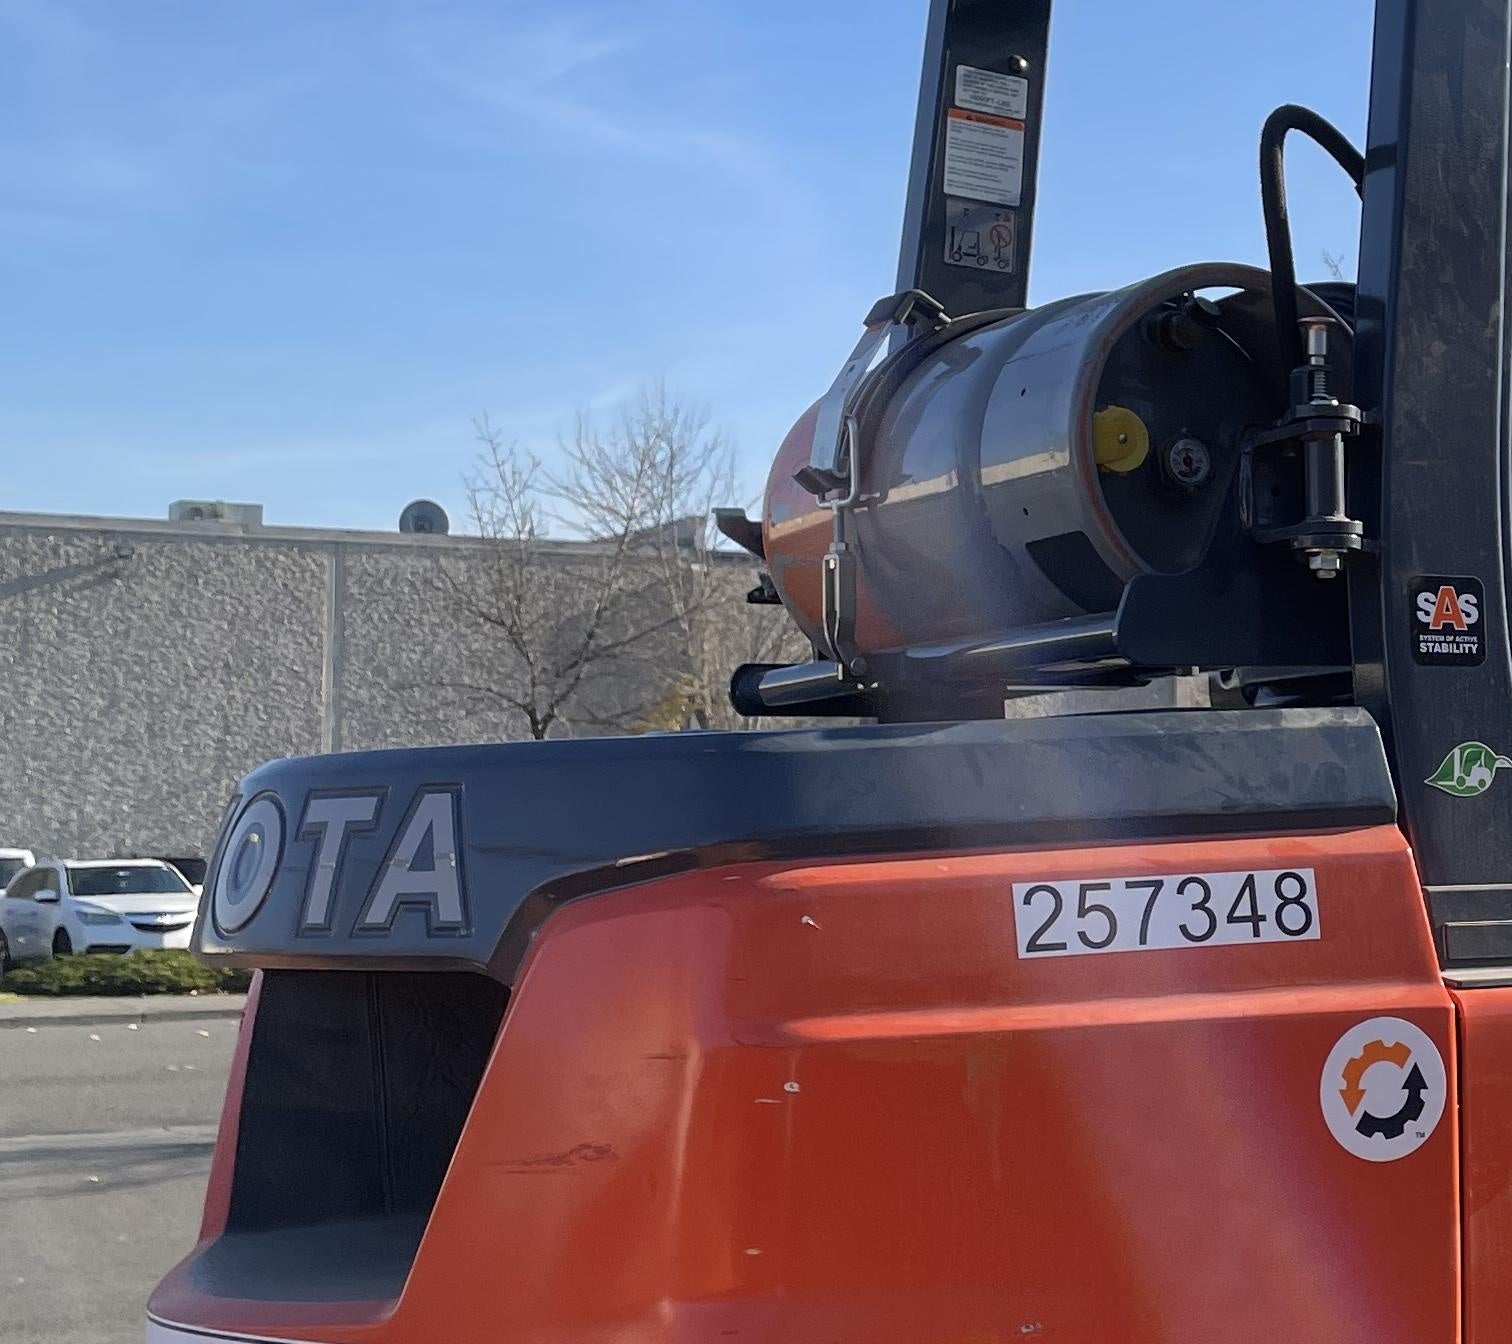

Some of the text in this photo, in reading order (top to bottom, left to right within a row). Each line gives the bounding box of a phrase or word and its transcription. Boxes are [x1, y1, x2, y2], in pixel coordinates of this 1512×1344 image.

[1416, 585, 1479, 631] SAS
[1419, 642, 1478, 654] STABILITY
[212, 786, 472, 939] OTA
[1022, 871, 1313, 953] 257348
